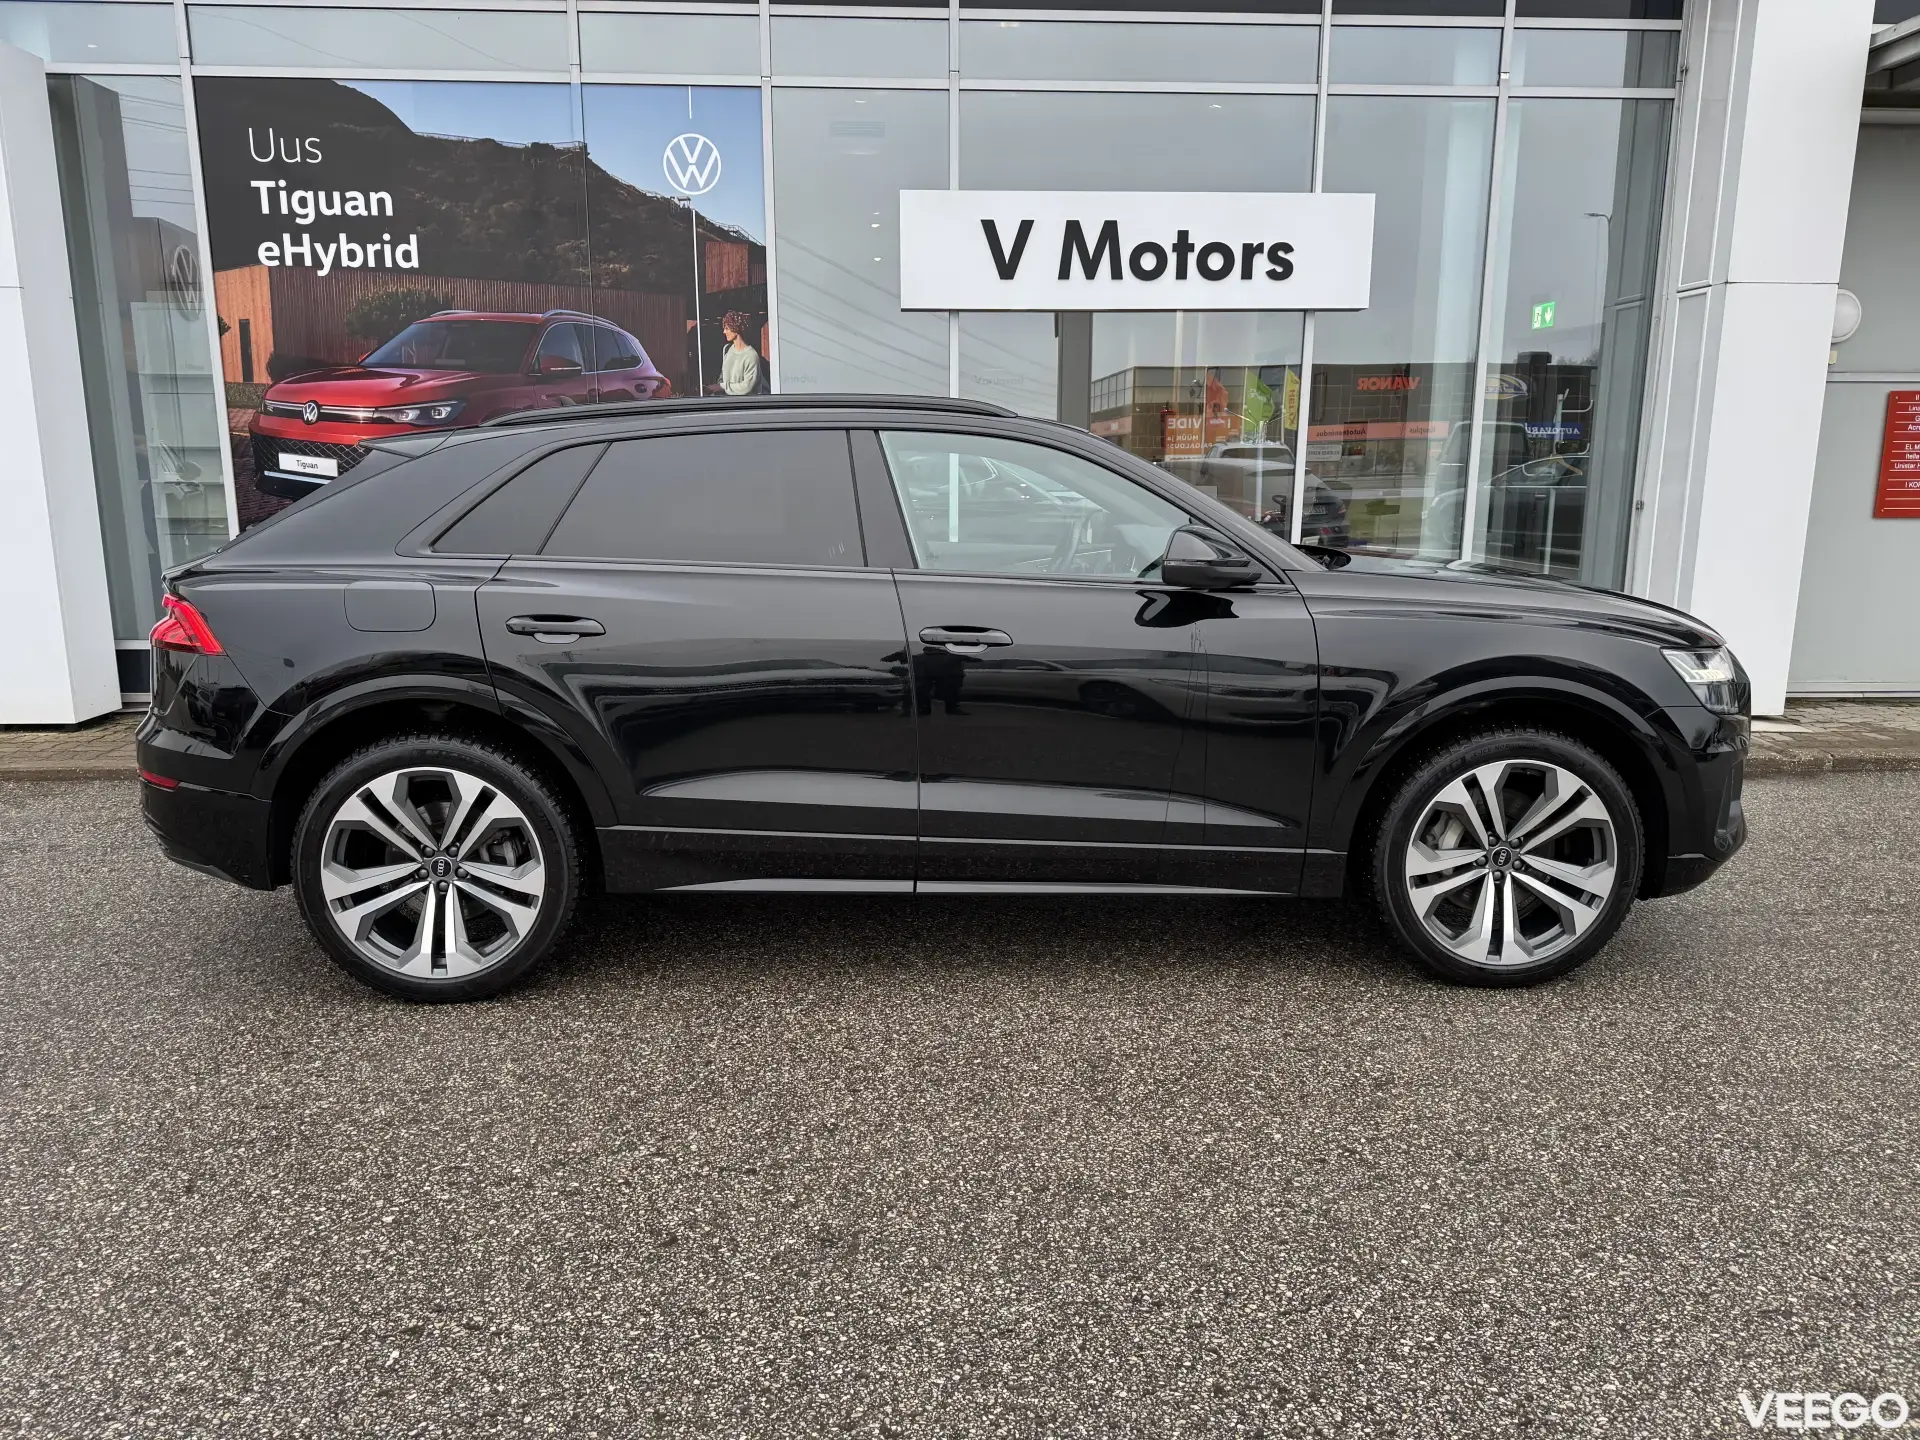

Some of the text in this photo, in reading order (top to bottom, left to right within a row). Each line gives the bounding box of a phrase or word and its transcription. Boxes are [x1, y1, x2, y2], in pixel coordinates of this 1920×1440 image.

[248, 127, 323, 165] Uus
[250, 179, 394, 227] Tiguan
[257, 232, 420, 277] eHybrid
[980, 219, 1295, 282] V Motors
[295, 459, 319, 471] Tiguan
